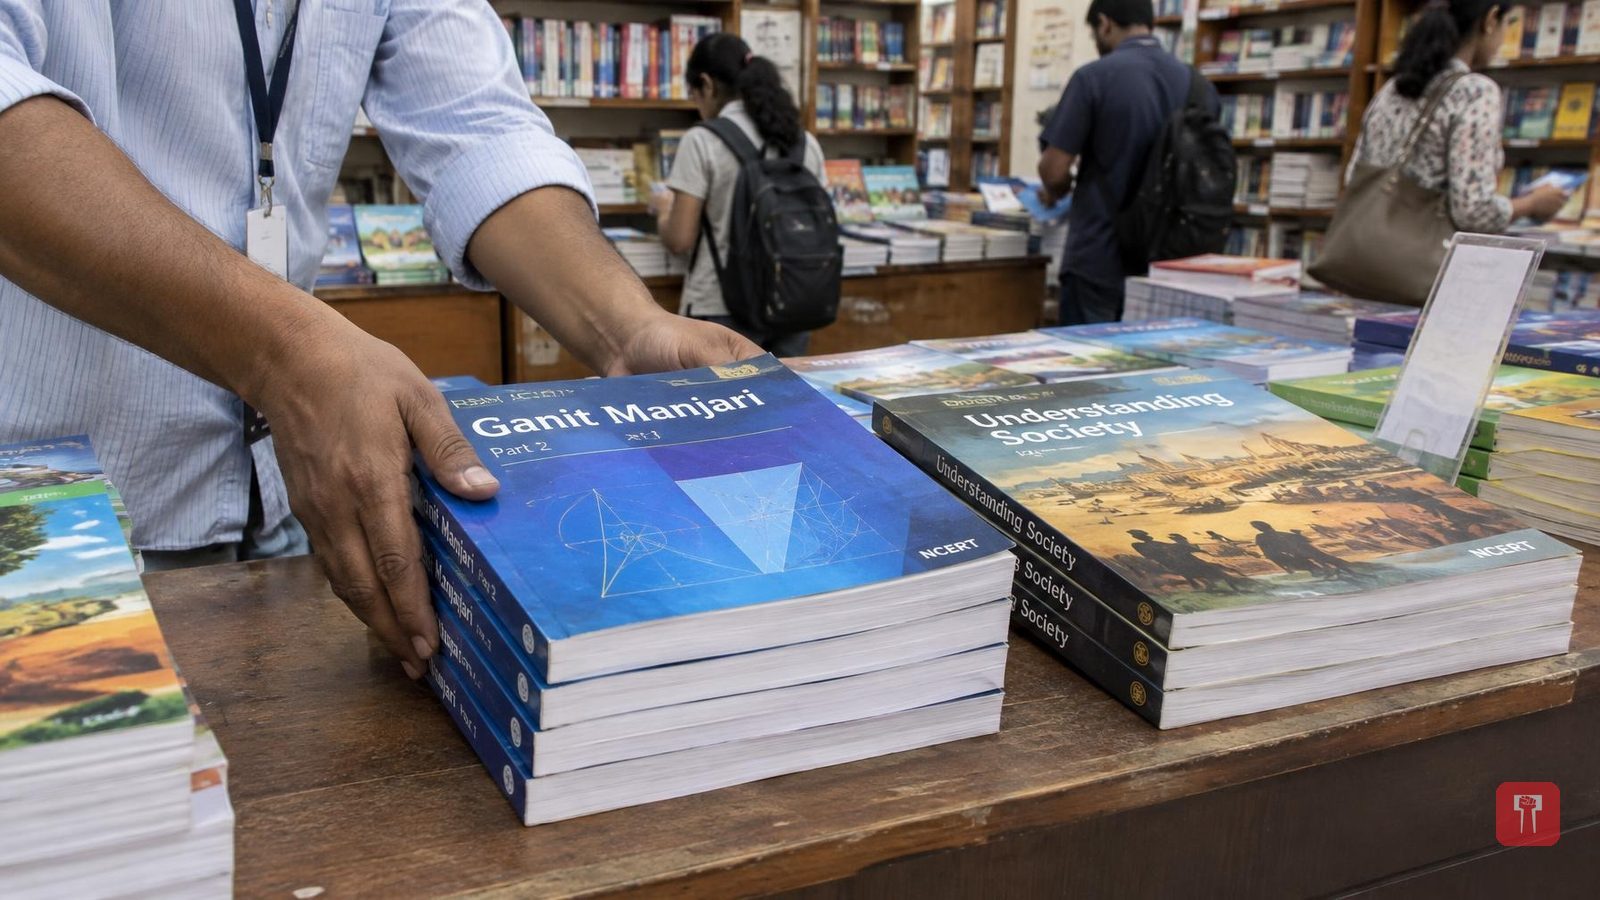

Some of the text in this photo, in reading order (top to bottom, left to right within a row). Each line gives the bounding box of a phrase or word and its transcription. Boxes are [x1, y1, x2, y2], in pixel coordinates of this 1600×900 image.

[472, 408, 600, 438] Ganit
[600, 388, 765, 425] Manjari
[965, 388, 1234, 430] Understanding
[490, 441, 552, 458] Part 2
[990, 418, 1143, 446] Society
[918, 538, 979, 560] NCERT
[1026, 520, 1077, 571] Society
[1468, 540, 1537, 559] NCERT
[1024, 561, 1073, 611] Society
[1020, 599, 1069, 649] Society
